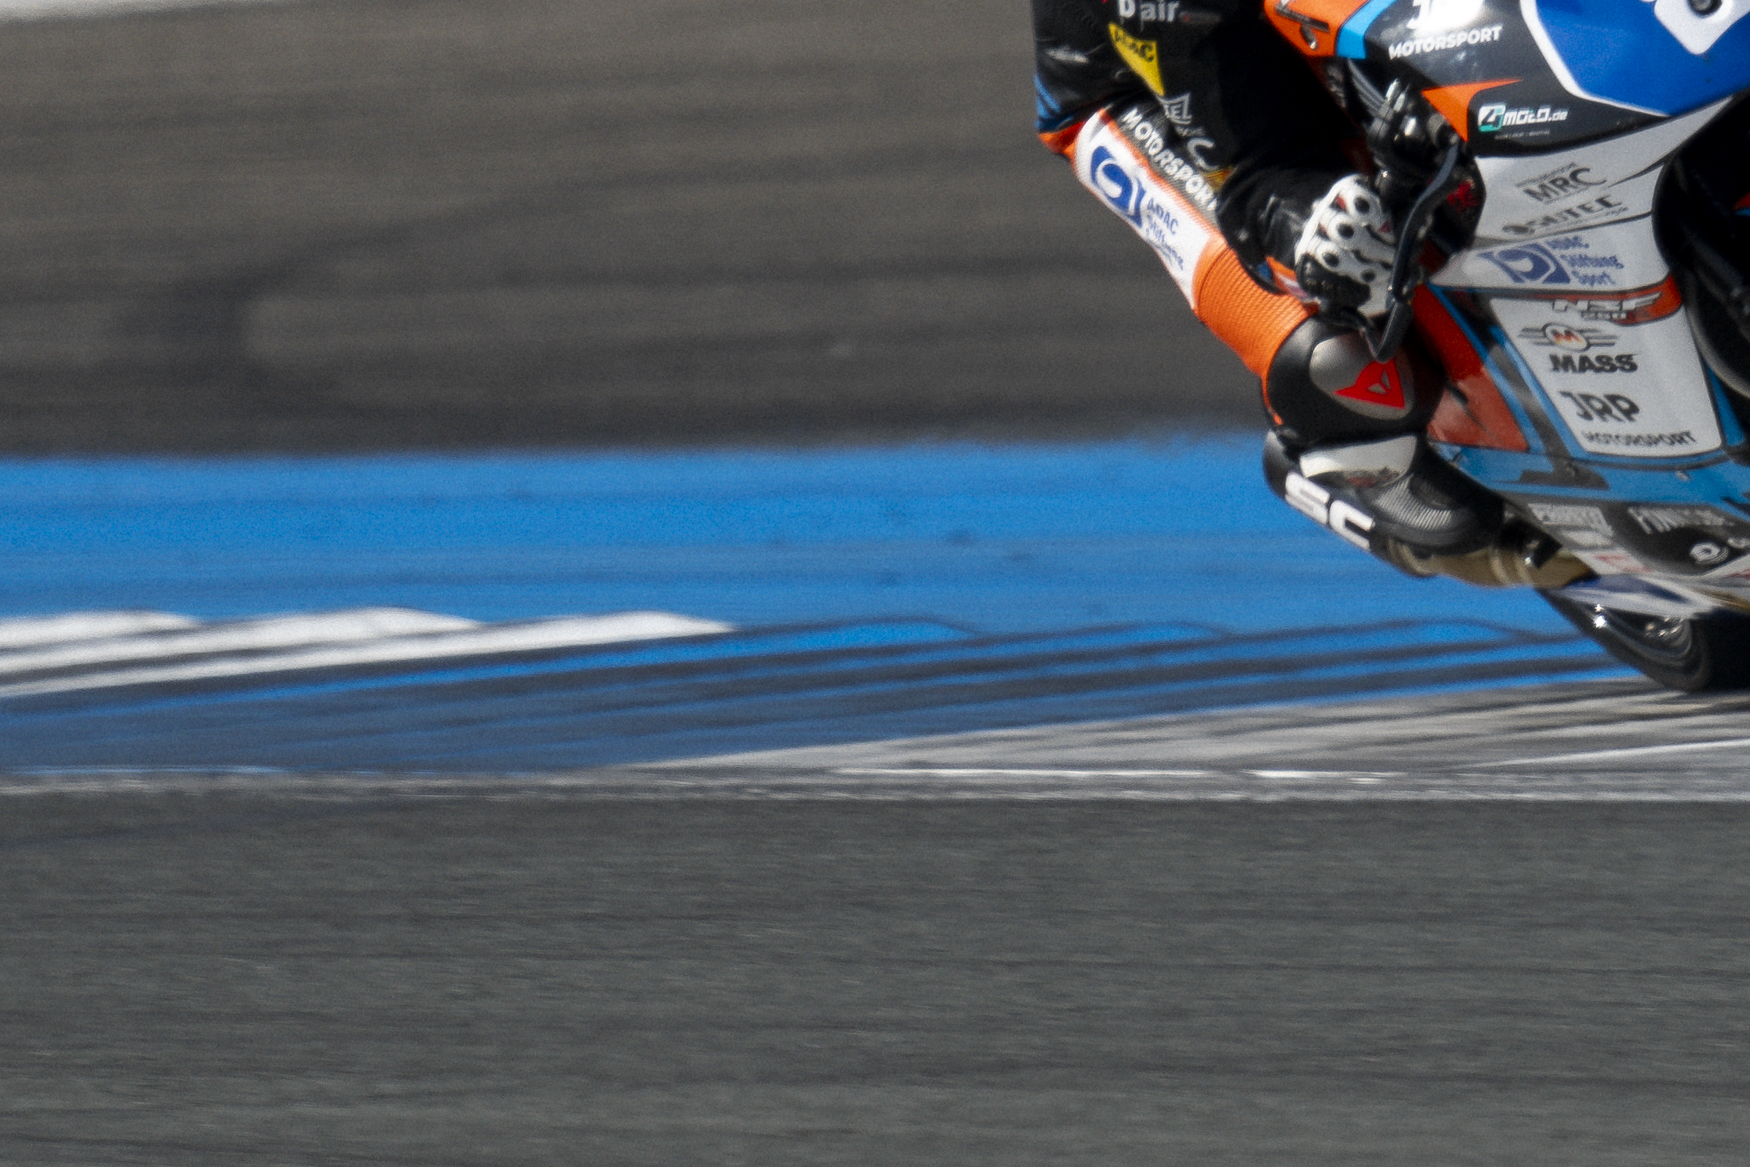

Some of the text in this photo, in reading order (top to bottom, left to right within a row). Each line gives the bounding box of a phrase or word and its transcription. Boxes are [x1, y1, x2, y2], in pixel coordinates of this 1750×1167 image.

[1389, 25, 1503, 60] MOTORSPORT
[1523, 167, 1607, 203] MRC
[1549, 353, 1639, 373] MASS
[1558, 390, 1640, 423] JRP
